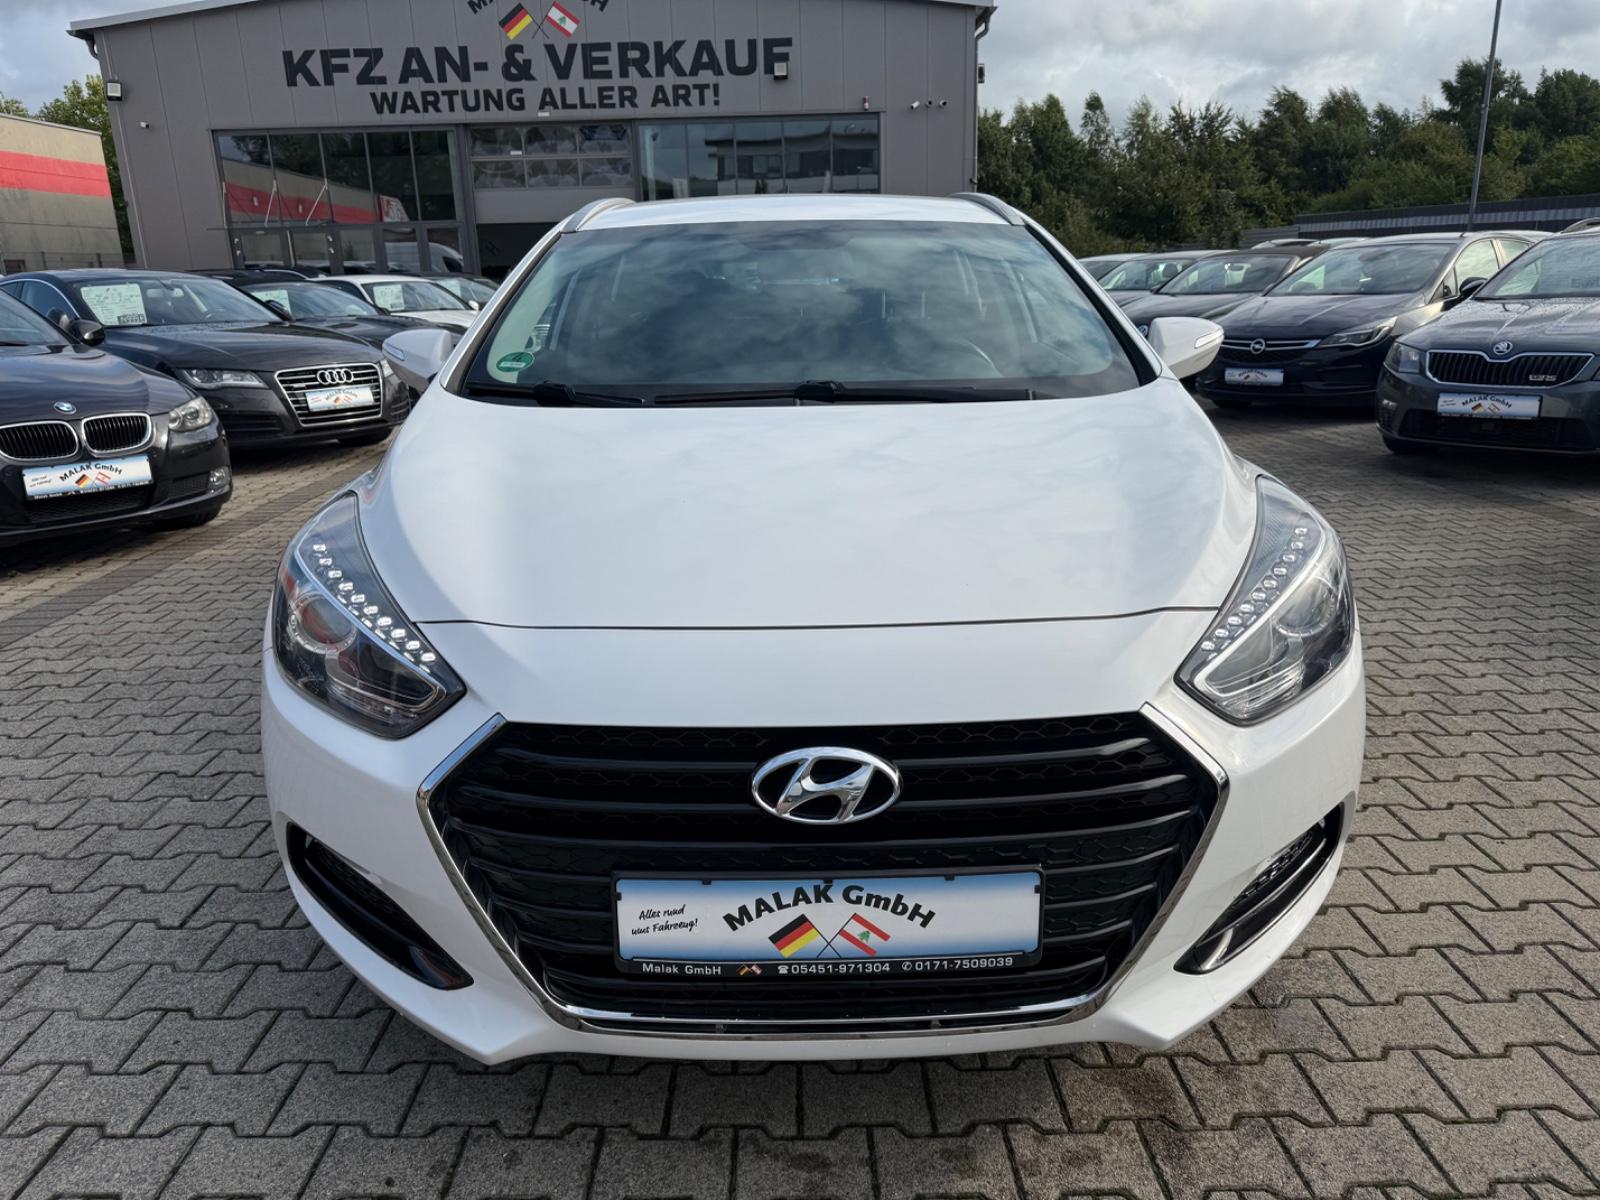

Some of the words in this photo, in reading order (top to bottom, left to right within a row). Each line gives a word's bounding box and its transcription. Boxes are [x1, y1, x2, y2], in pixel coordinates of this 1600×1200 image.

[282, 48, 388, 87] KFZ
[398, 46, 488, 84] AN-
[501, 43, 537, 82] &
[543, 37, 793, 80] VERKAUF
[369, 88, 526, 114] WARTUNG
[538, 86, 639, 110] ALLER
[651, 83, 720, 107] ART!
[59, 462, 92, 482] MALAK
[94, 463, 122, 475] GmbH
[638, 907, 661, 921] Alles
[663, 904, 687, 917] rund
[722, 884, 834, 932] MALAK
[842, 885, 936, 929] GmbH
[631, 926, 650, 936] ums
[652, 918, 699, 933] Fahrzeug!
[642, 963, 679, 974] Malak
[685, 965, 722, 976] GmbH
[791, 963, 890, 975] 05451-971304
[915, 957, 1013, 971] 0171-7509039
